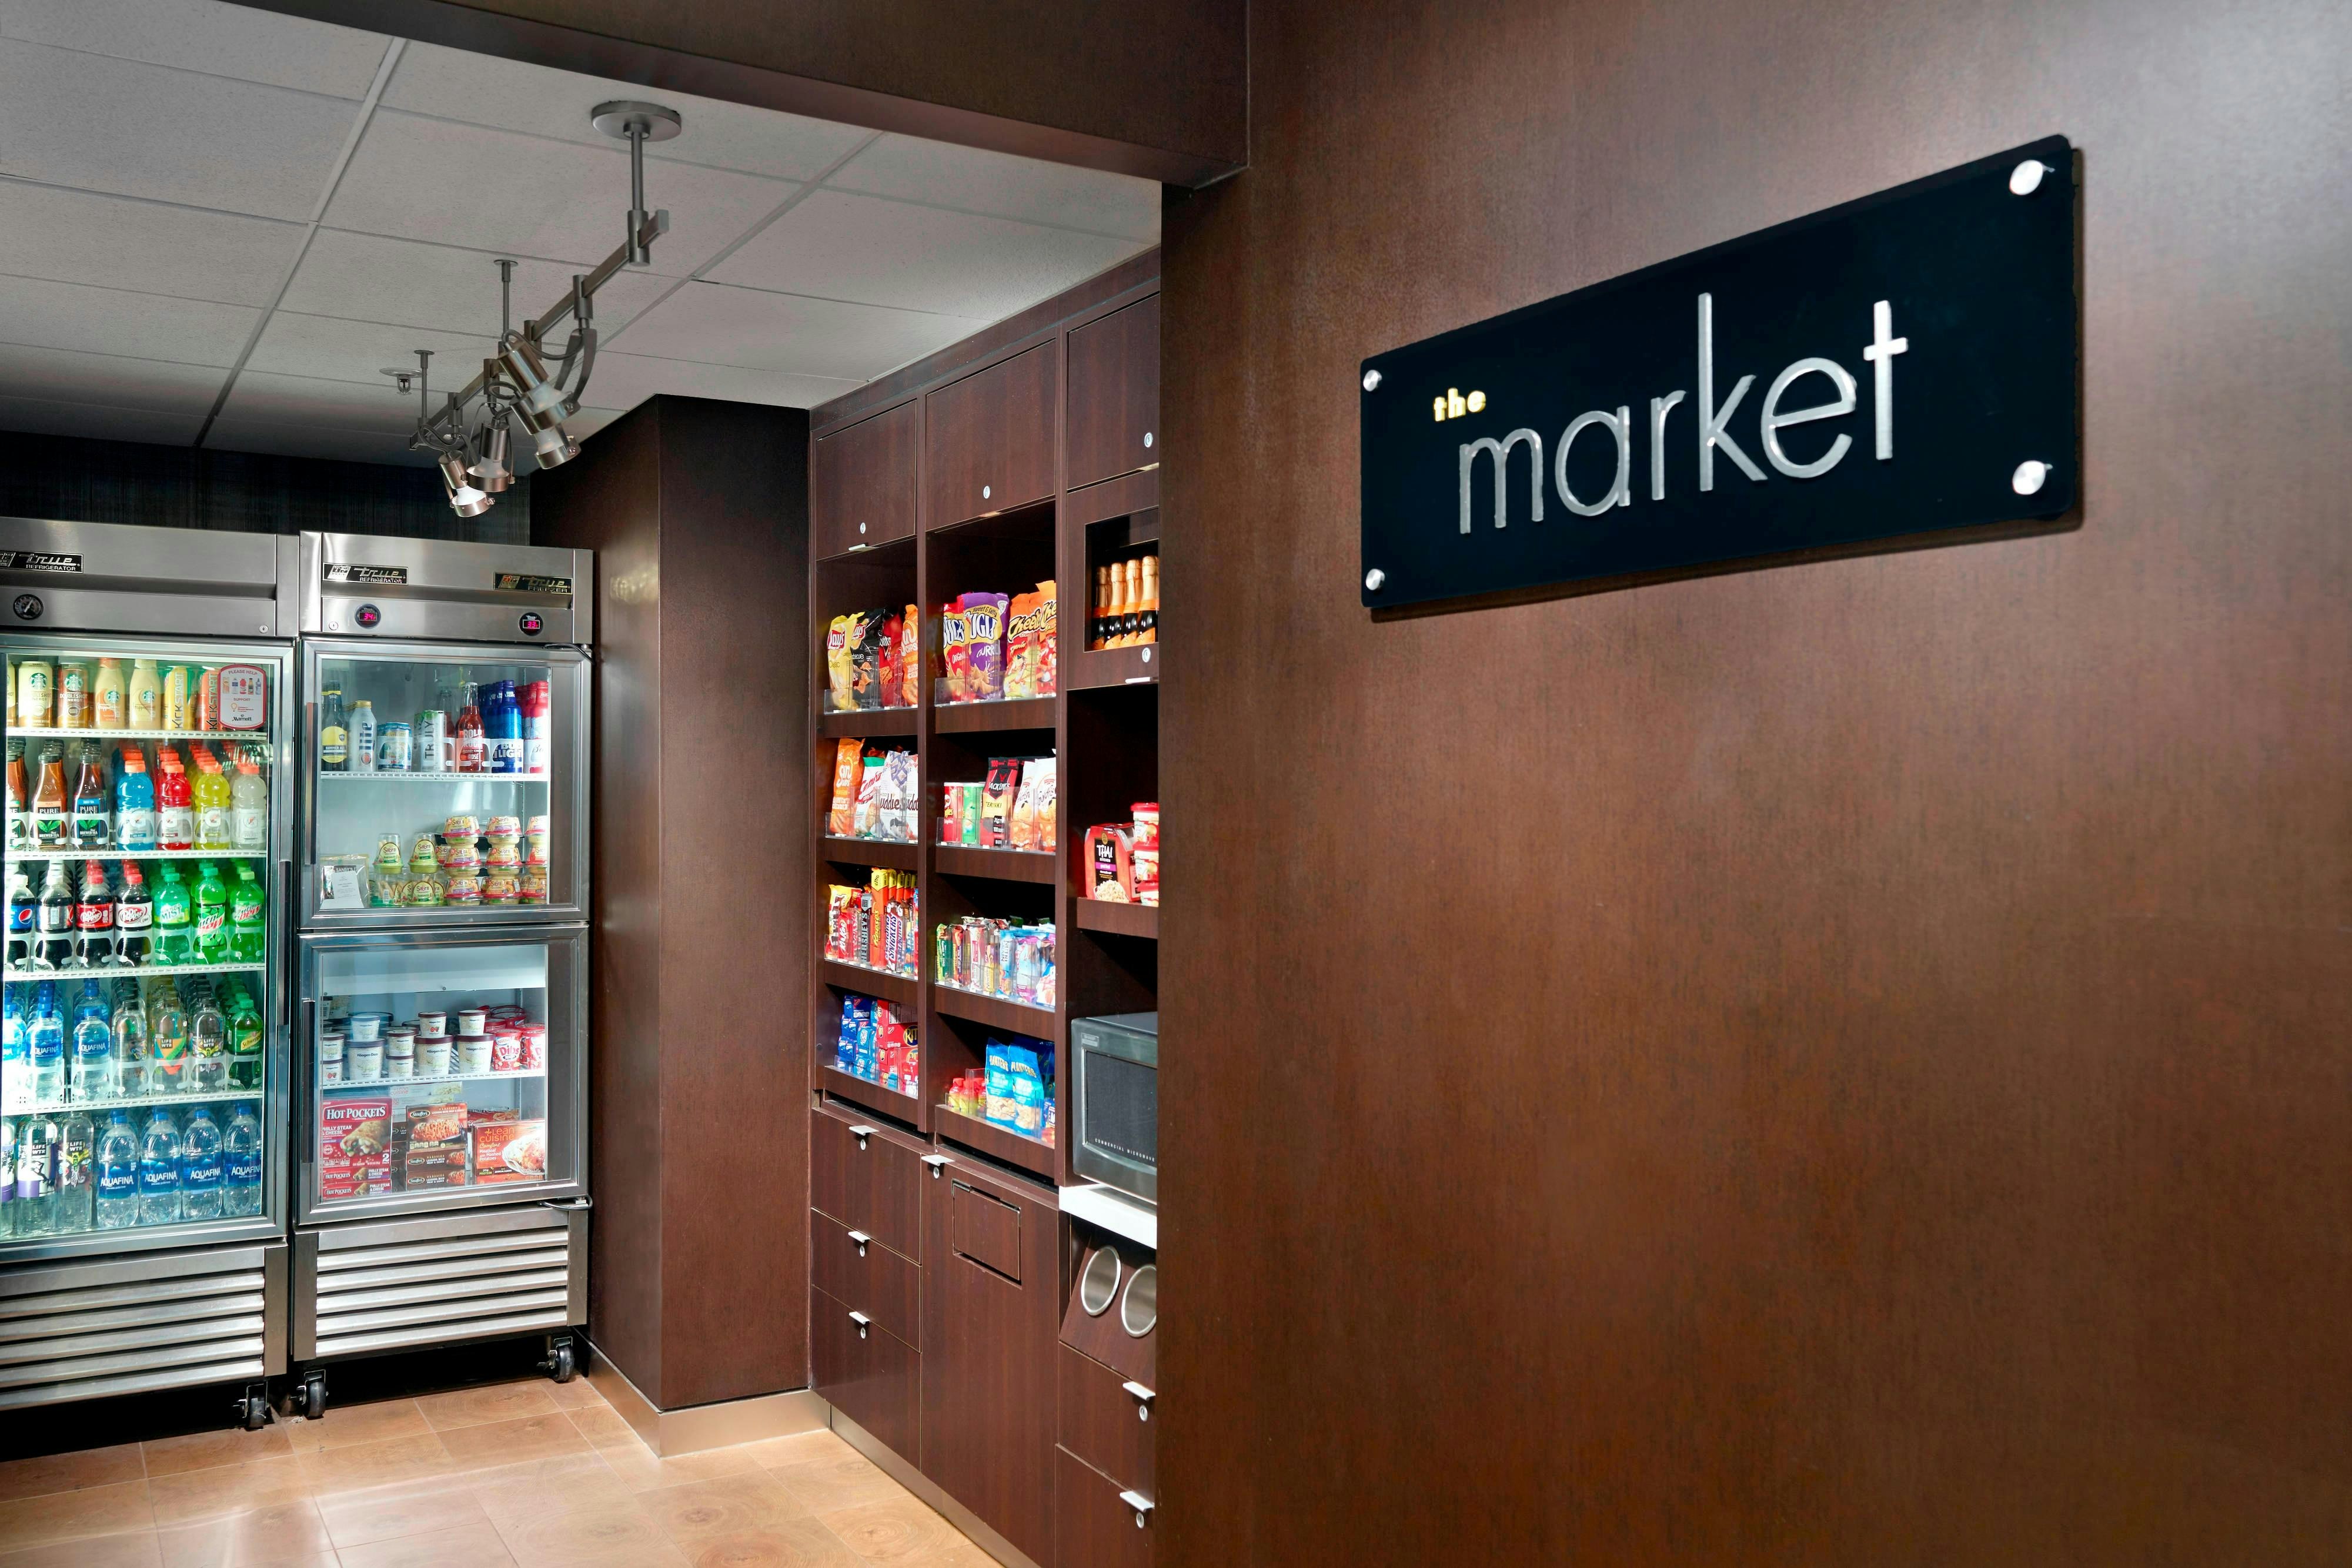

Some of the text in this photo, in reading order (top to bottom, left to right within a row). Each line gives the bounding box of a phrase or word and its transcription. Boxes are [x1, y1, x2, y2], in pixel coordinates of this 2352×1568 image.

[1432, 387, 1486, 423] the
[1458, 292, 1909, 535] market
[354, 567, 403, 579] true
[827, 631, 846, 650] Lay's
[172, 671, 185, 729] KICKSTART
[206, 673, 218, 730] KICKSTART
[1096, 844, 1113, 858] THAI
[860, 912, 868, 961] HERSHEY'S
[889, 913, 897, 959] SNICKERS
[906, 1028, 918, 1044] RIT
[29, 1046, 59, 1055] AQUAFINA
[77, 1042, 106, 1052] AQUAFINA
[1011, 1061, 1037, 1078] PLANTERS
[326, 1106, 386, 1120] HOT POCKETS
[382, 1153, 390, 1162] 2
[1094, 1138, 1155, 1162] COMMERCIAL MICROWAVE
[100, 1175, 134, 1187] AQUAFINA
[145, 1171, 178, 1183] AQUAFINA
[190, 1166, 221, 1180] AQUAFINA
